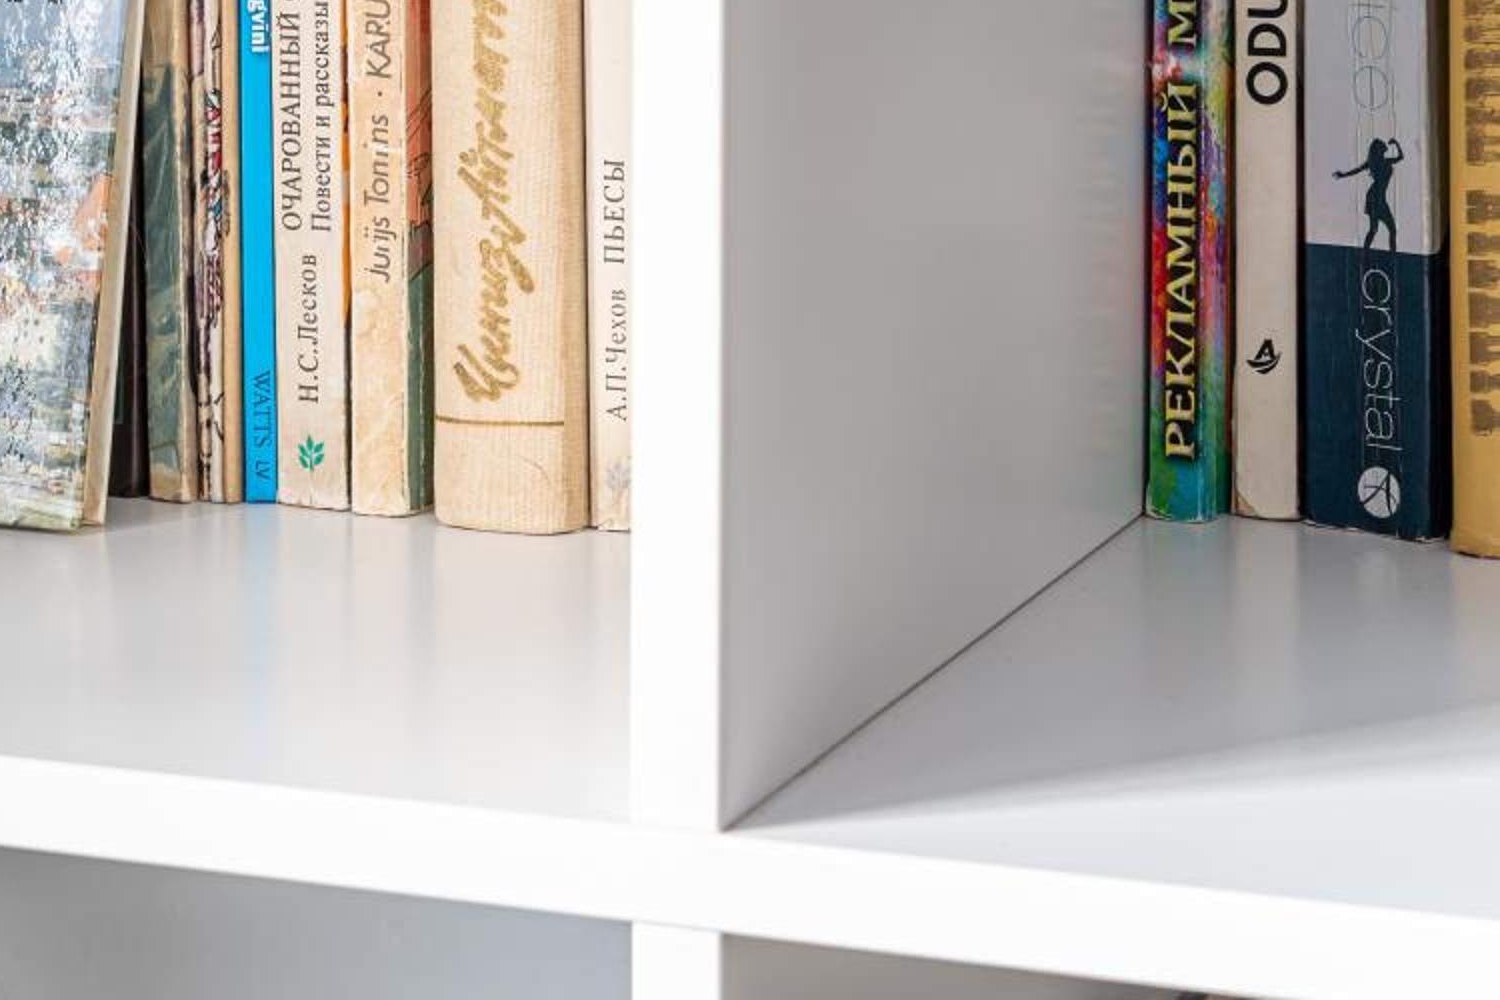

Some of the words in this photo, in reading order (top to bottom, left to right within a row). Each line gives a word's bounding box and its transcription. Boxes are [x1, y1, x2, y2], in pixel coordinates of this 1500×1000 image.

[313, 1, 334, 108] рассказы
[278, 12, 304, 232] ОЧАРОВАННЫЙ
[315, 115, 331, 128] и
[311, 137, 332, 232] Повести
[602, 159, 626, 265] ПЬЕСЫ
[363, 216, 397, 285] Jurijs
[1161, 81, 1198, 460] РЕКЛАМНЫЙ
[297, 253, 319, 404] Н.С.Лесков
[604, 288, 628, 422] А.П.Чехов
[1354, 268, 1404, 452] crystal
[253, 370, 271, 449] WATTS
[255, 460, 271, 481] LV
